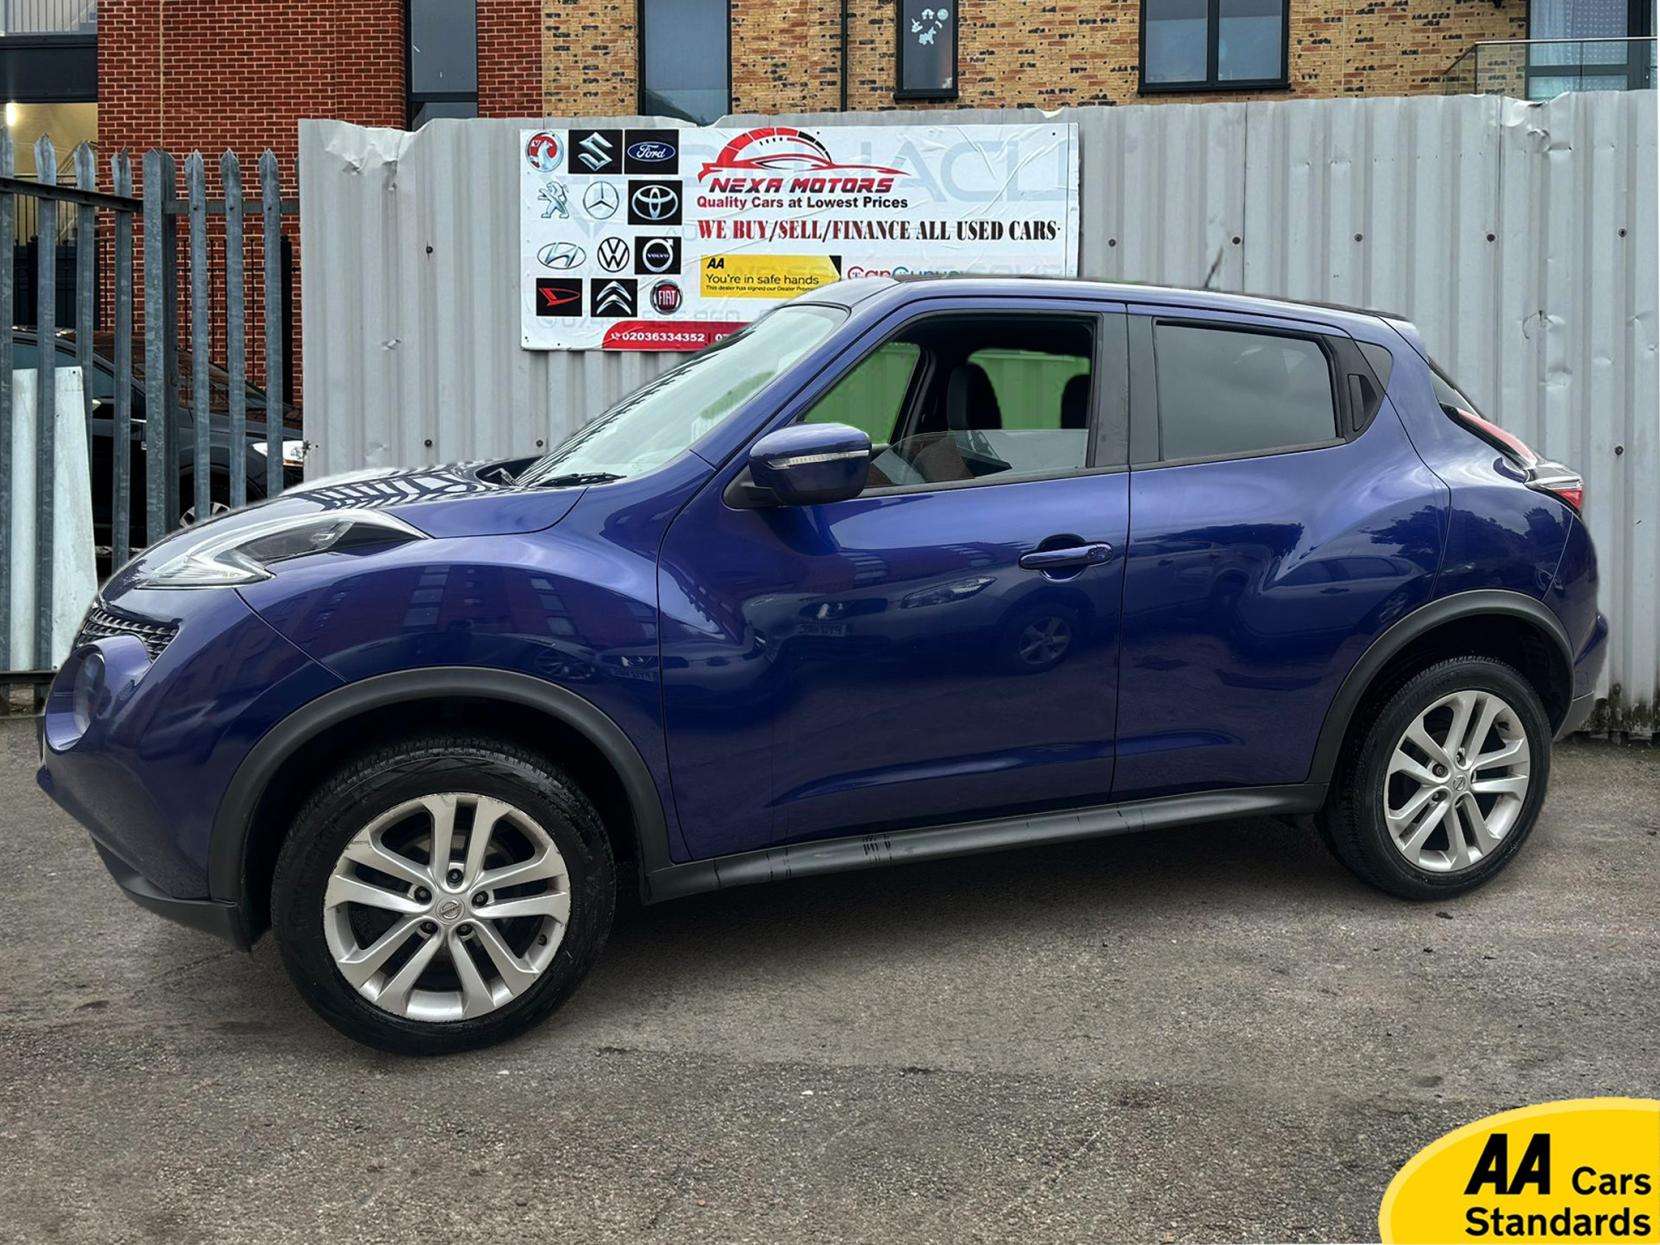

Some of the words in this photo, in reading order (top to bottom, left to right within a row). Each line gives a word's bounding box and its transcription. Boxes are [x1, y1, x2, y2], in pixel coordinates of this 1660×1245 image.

[636, 143, 666, 159] Ford
[709, 177, 784, 194] NEXA
[789, 177, 894, 194] MOTORS
[696, 195, 748, 211] Quality
[752, 195, 784, 208] Cars
[788, 196, 802, 208] at
[807, 195, 859, 208] Lowest
[863, 196, 908, 209] Prices
[697, 219, 727, 241] WE
[915, 219, 951, 241] ALL
[956, 219, 1004, 241] USED
[1008, 219, 1057, 241] CARS
[706, 257, 725, 269] AA
[705, 273, 741, 284] You're
[744, 273, 754, 284] in
[757, 273, 781, 285] safe
[784, 274, 819, 285] hands
[658, 290, 676, 306] FIAT
[622, 332, 705, 342] 02036334352
